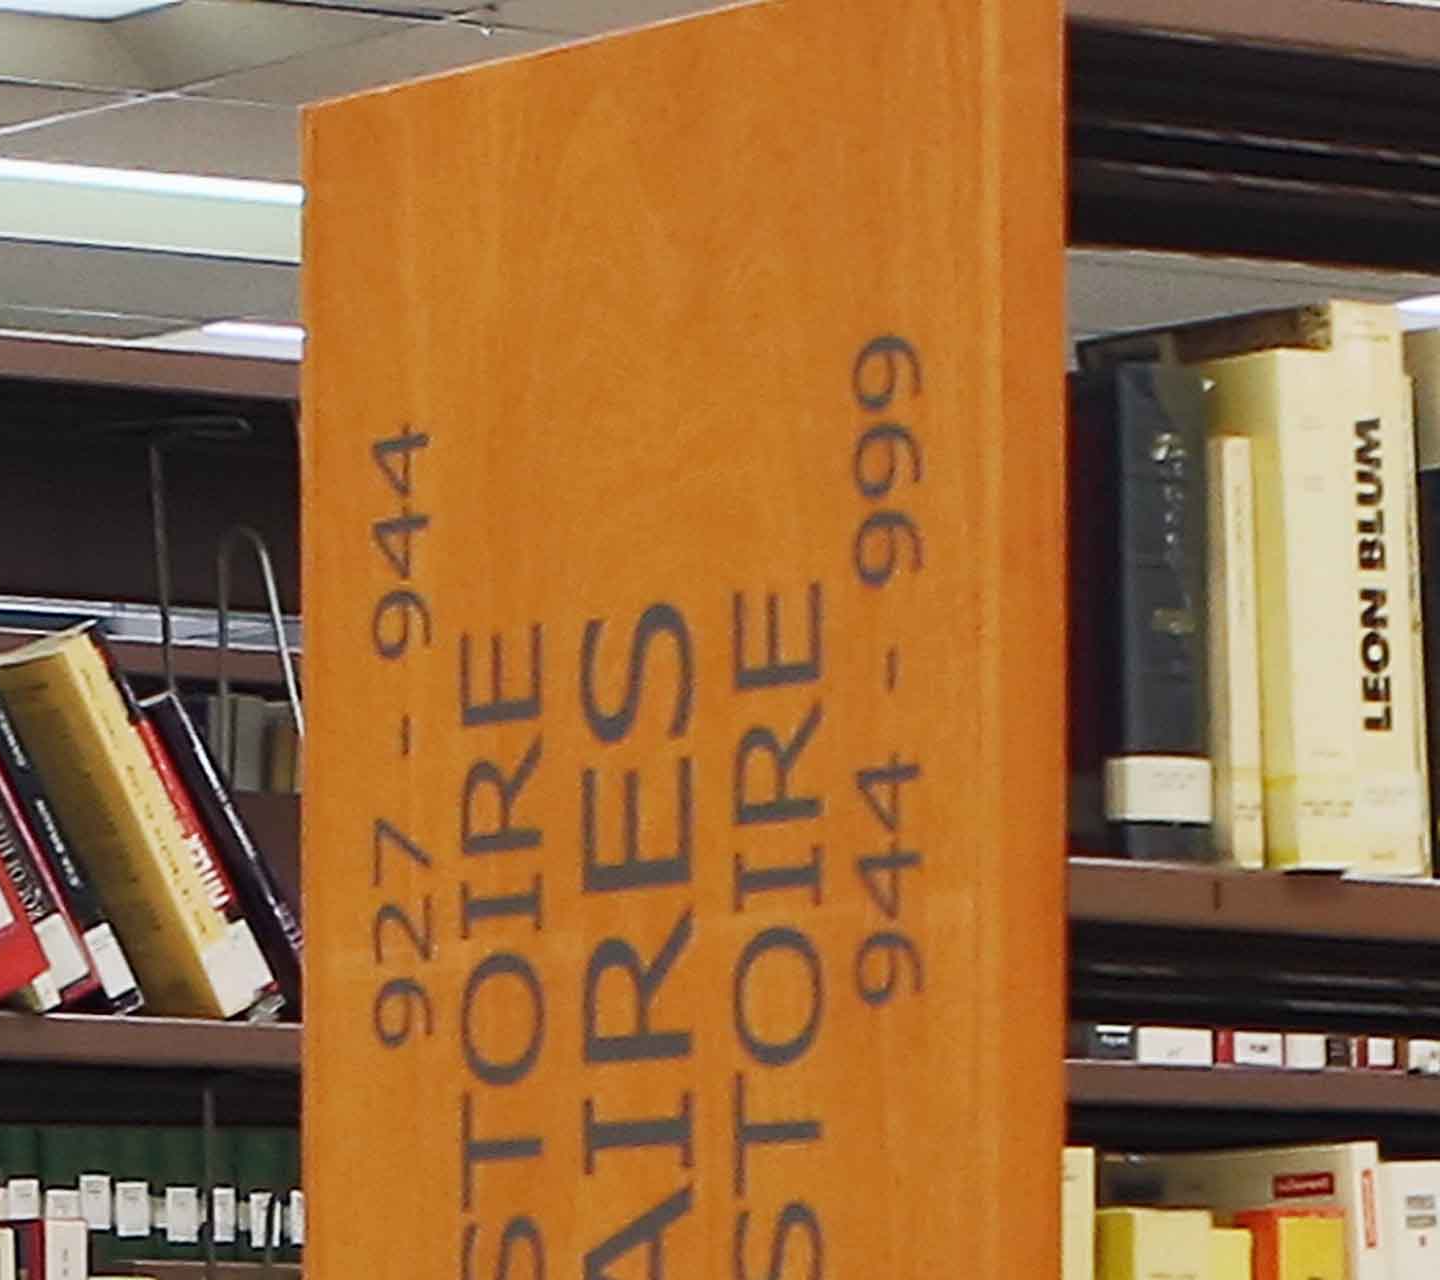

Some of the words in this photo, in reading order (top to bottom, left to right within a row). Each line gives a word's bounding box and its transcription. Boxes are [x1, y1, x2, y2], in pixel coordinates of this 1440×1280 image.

[373, 425, 432, 662] 944
[855, 334, 921, 588] 999
[1355, 417, 1385, 571] BLUM
[1360, 589, 1393, 731] LEON
[374, 819, 432, 1050] 927
[855, 750, 923, 1006] 944
